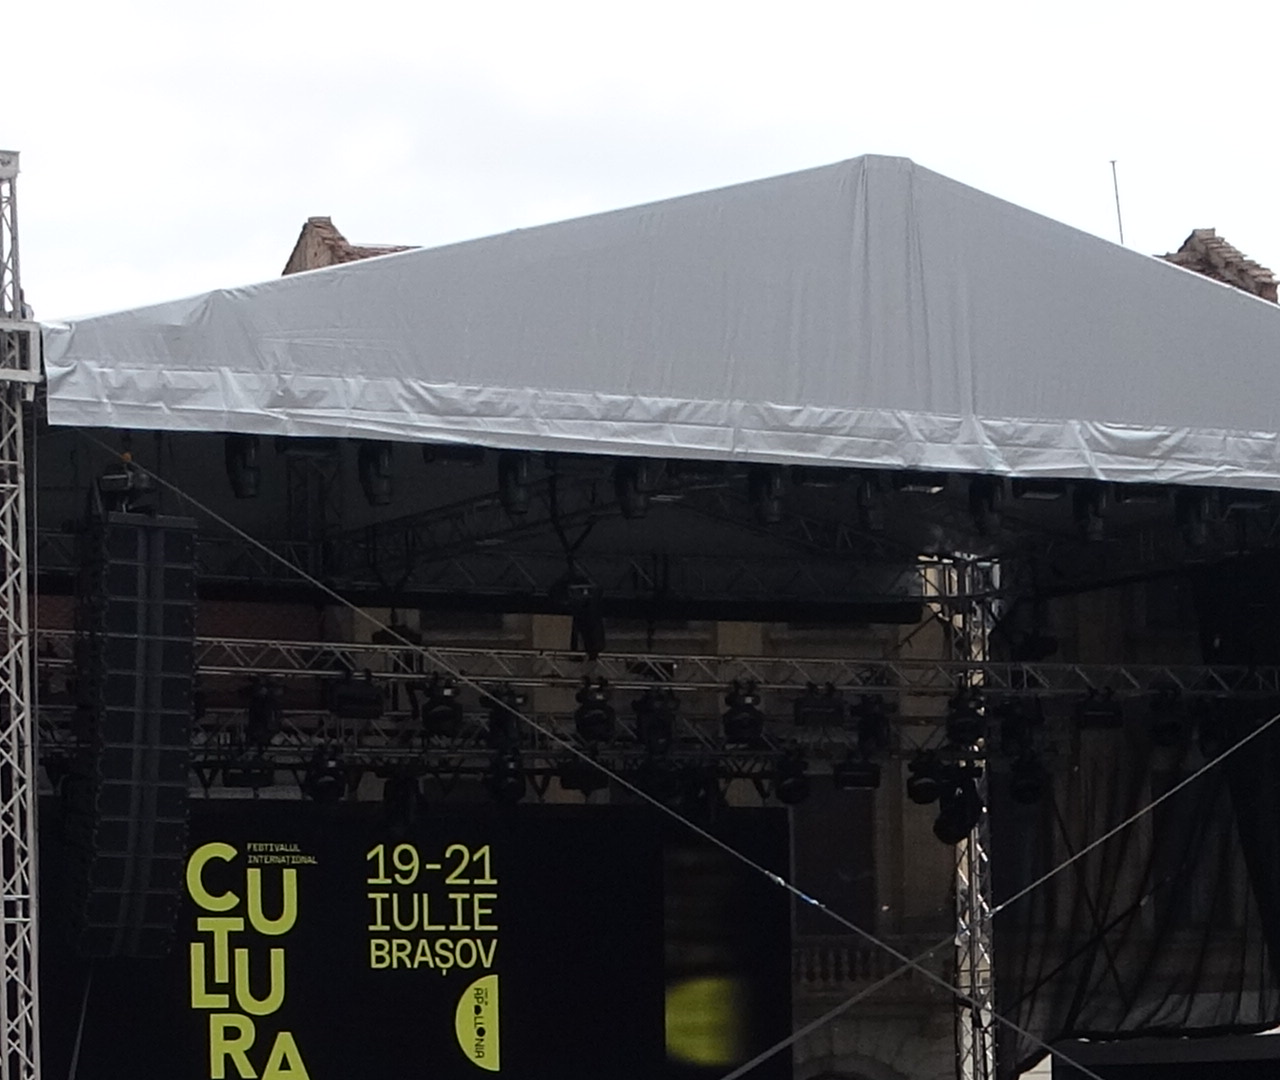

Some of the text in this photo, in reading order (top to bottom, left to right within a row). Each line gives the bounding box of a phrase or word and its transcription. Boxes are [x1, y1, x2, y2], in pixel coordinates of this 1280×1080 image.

[366, 843, 498, 885] 19-21
[367, 893, 498, 931] IULIE
[370, 938, 498, 976] BRAȘOV
